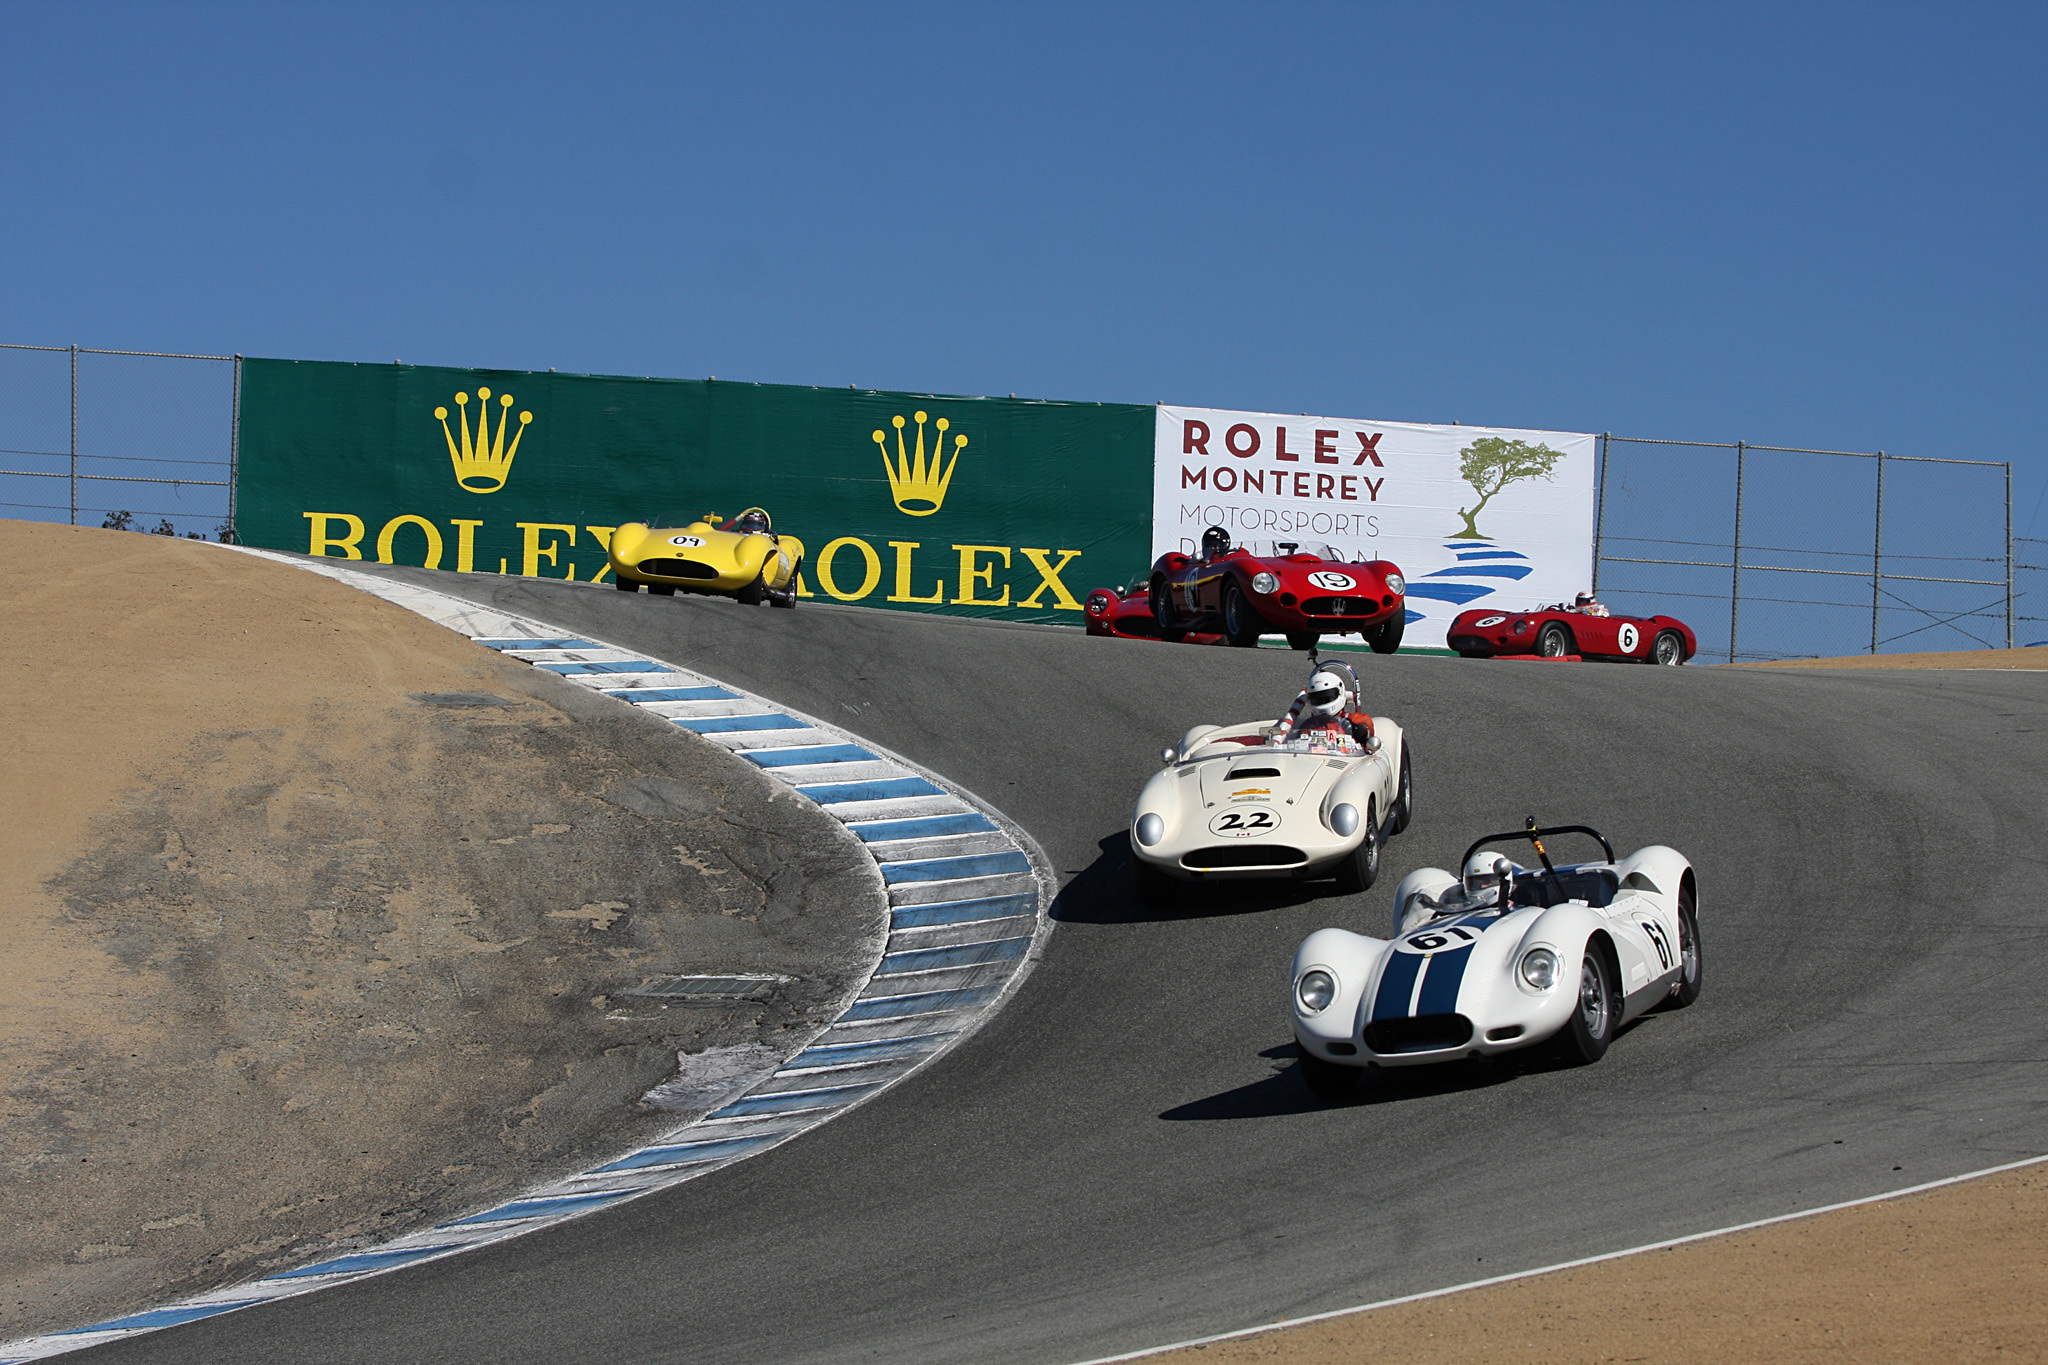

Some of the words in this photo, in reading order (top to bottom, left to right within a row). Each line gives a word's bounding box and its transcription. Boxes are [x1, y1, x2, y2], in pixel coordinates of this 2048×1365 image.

[1182, 419, 1385, 468] ROLEX
[1181, 464, 1385, 501] MONTEREY
[1179, 503, 1380, 538] MOTORSPORTS
[673, 536, 700, 547] 09
[797, 536, 1084, 611] OLEX
[1313, 573, 1351, 588] 19
[1623, 625, 1633, 647] 6
[1217, 812, 1274, 831] 22
[1407, 927, 1475, 950] 61
[1641, 919, 1674, 971] 61
